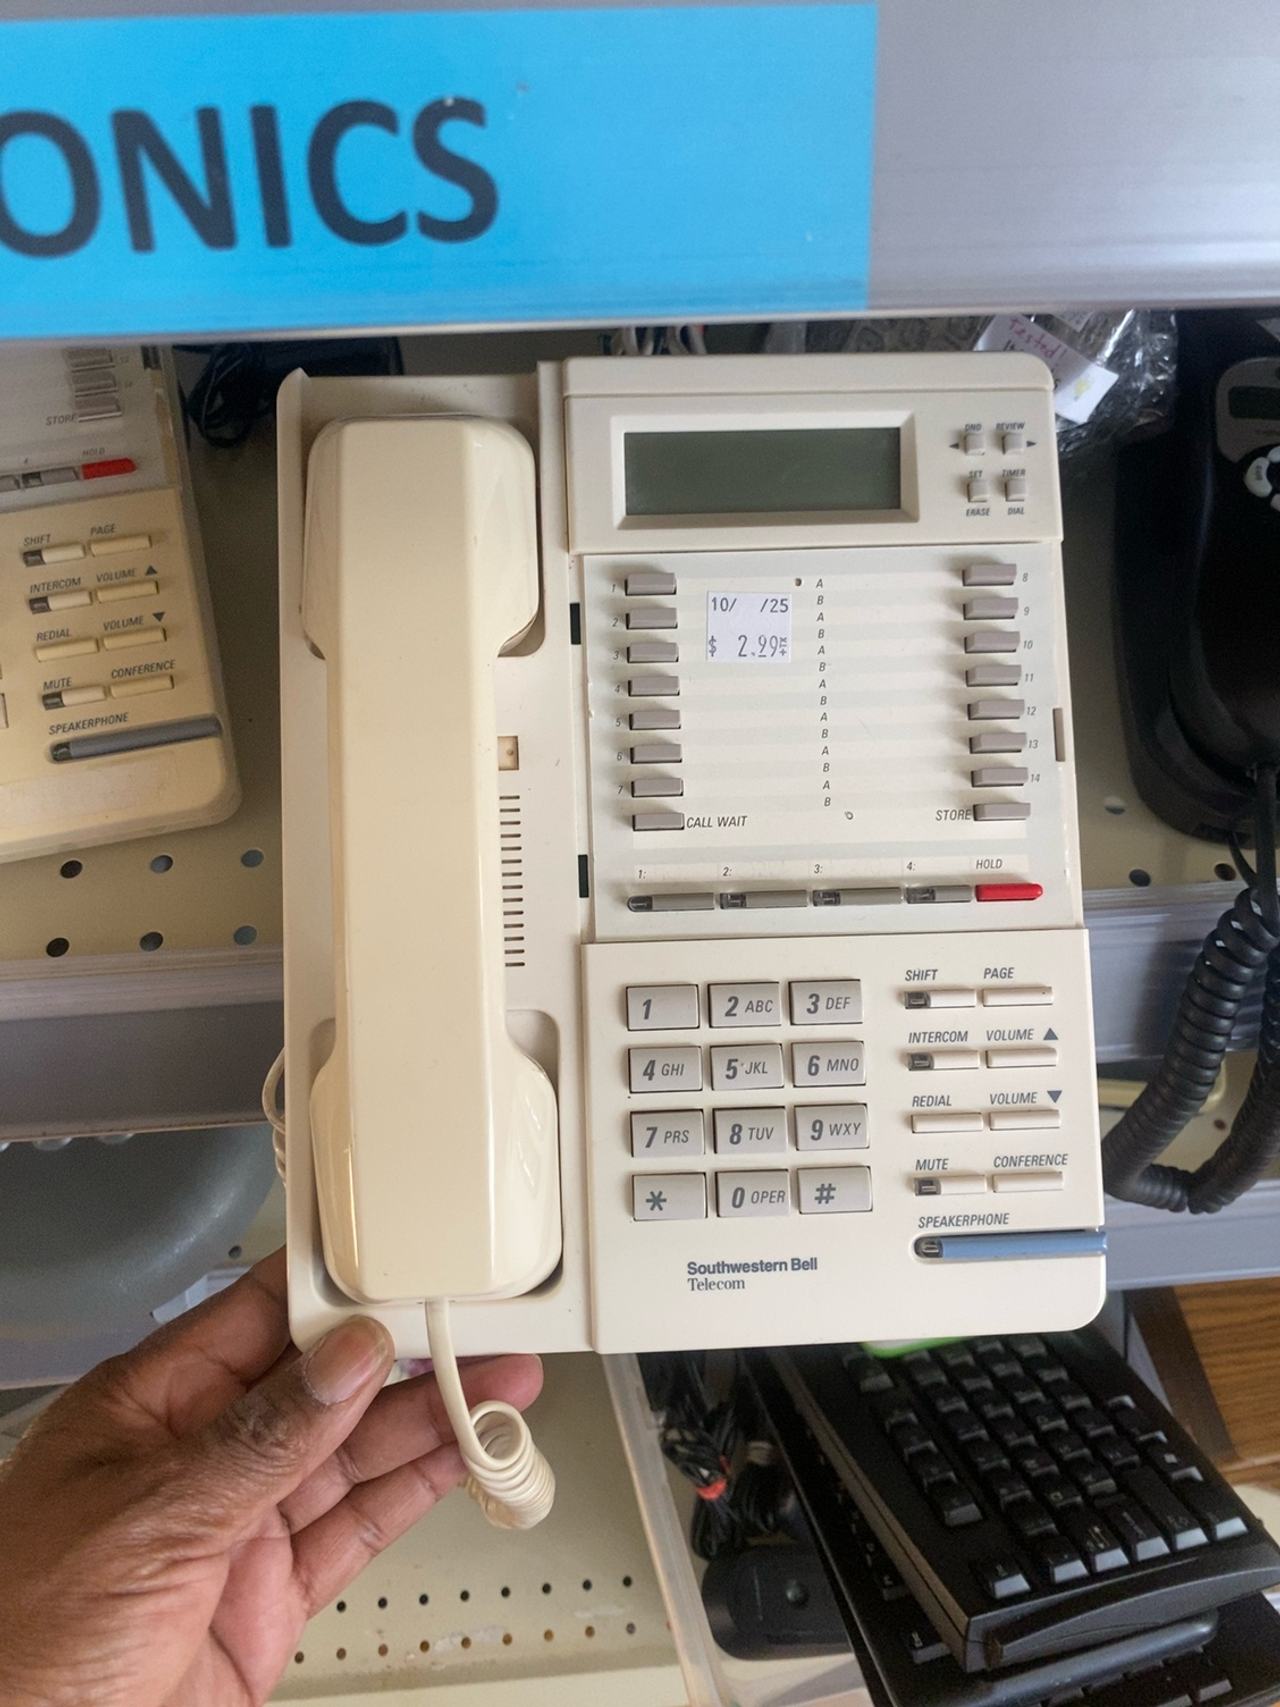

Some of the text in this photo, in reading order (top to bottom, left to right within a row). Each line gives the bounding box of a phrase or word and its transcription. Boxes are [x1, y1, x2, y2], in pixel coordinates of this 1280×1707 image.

[0, 96, 499, 258] ONICS
[965, 424, 982, 432] DND
[996, 422, 1025, 430] REVIEW
[969, 470, 983, 478] SET
[1002, 469, 1026, 477] TIMER
[966, 508, 990, 516] ERASE
[1008, 507, 1024, 515] DIAL
[91, 524, 116, 536] PAGE
[23, 534, 51, 546] SHIFT
[96, 568, 137, 583] VOLUME
[1023, 573, 1028, 582] 8
[30, 577, 81, 593] INTERCOM
[816, 579, 824, 588] A
[711, 597, 789, 613] 10/ /25
[817, 596, 824, 605] B
[816, 612, 824, 621] A
[1024, 607, 1029, 616] 9
[104, 616, 144, 631] VOLUME
[36, 629, 71, 641] REDIAL
[818, 629, 825, 638] B
[817, 646, 825, 654] A
[1023, 641, 1033, 649] 10
[111, 660, 176, 678] CONFERENCE
[819, 662, 826, 671] B
[43, 677, 72, 690] MUTE
[819, 679, 826, 688] A
[1025, 674, 1034, 682] 11
[820, 696, 827, 705] B
[820, 712, 828, 722] A
[1027, 707, 1036, 715] 12
[49, 712, 128, 735] SPEAKERPHONE
[821, 729, 828, 738] B
[821, 746, 829, 755] A
[1028, 740, 1038, 749] 13
[823, 763, 830, 772] B
[1030, 774, 1040, 782] 14
[823, 780, 830, 789] A
[824, 797, 831, 806] B
[936, 808, 971, 821] STORE
[687, 815, 747, 829] CALL WAIT
[976, 859, 1002, 870] HOLD
[905, 969, 938, 981] SHIFT
[984, 967, 1015, 979] PAGE
[643, 999, 652, 1020] 1
[725, 996, 773, 1017] 2 ABC
[806, 993, 850, 1014] 3 DEF
[908, 1030, 968, 1043] INTERCOM
[986, 1029, 1034, 1041] VOLUME
[643, 1060, 684, 1081] 4 GHI
[726, 1058, 768, 1080] 5 JKL
[807, 1055, 859, 1076] 6 MNO
[912, 1095, 952, 1107] REDIAL
[990, 1092, 1038, 1105] VOLUME
[729, 1124, 774, 1145] 8 TUV
[810, 1119, 862, 1141] 9 WXY
[645, 1127, 689, 1148] 7 PRS
[915, 1158, 949, 1171] MUTE
[993, 1153, 1068, 1168] CONFERENCE
[731, 1187, 785, 1209] 0 OPER
[815, 1183, 836, 1204] #
[918, 1213, 1009, 1229] SPEAKERPHONE
[687, 1257, 818, 1275] Southwestern Bell
[687, 1277, 745, 1292] Telecom
